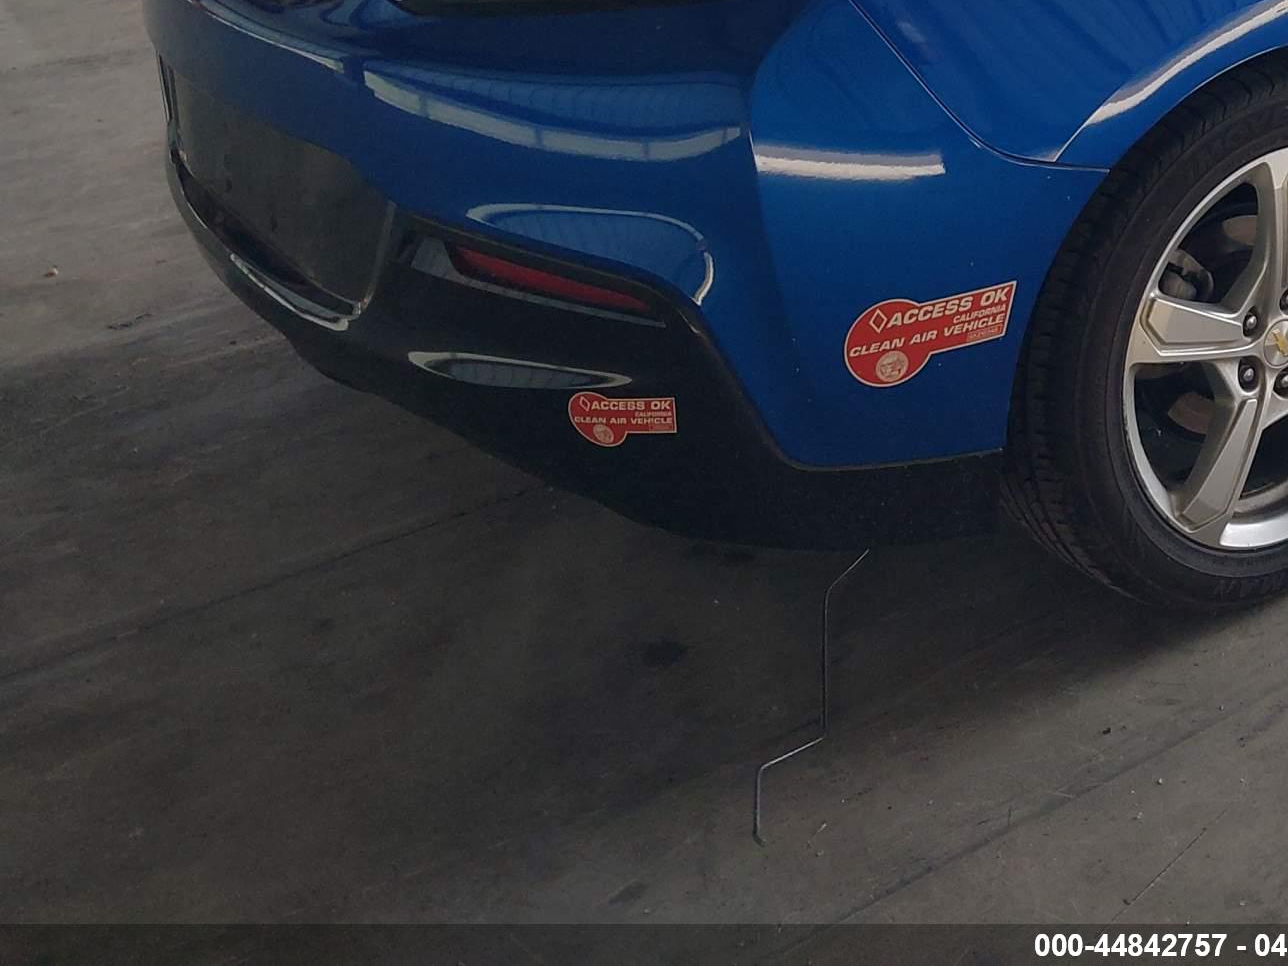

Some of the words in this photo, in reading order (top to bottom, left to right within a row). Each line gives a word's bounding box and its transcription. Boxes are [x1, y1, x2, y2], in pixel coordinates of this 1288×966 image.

[886, 296, 973, 328] ACCESS
[980, 286, 1011, 307] OK
[953, 304, 1007, 324] CALIFORNIA
[849, 337, 905, 357] CLEAN
[909, 330, 938, 345] AIR
[943, 313, 1005, 337] VEHICLE
[591, 400, 646, 411] ACCESS
[650, 400, 672, 410] OK
[574, 416, 607, 424] CLEAN
[630, 417, 673, 425] VEHICLE
